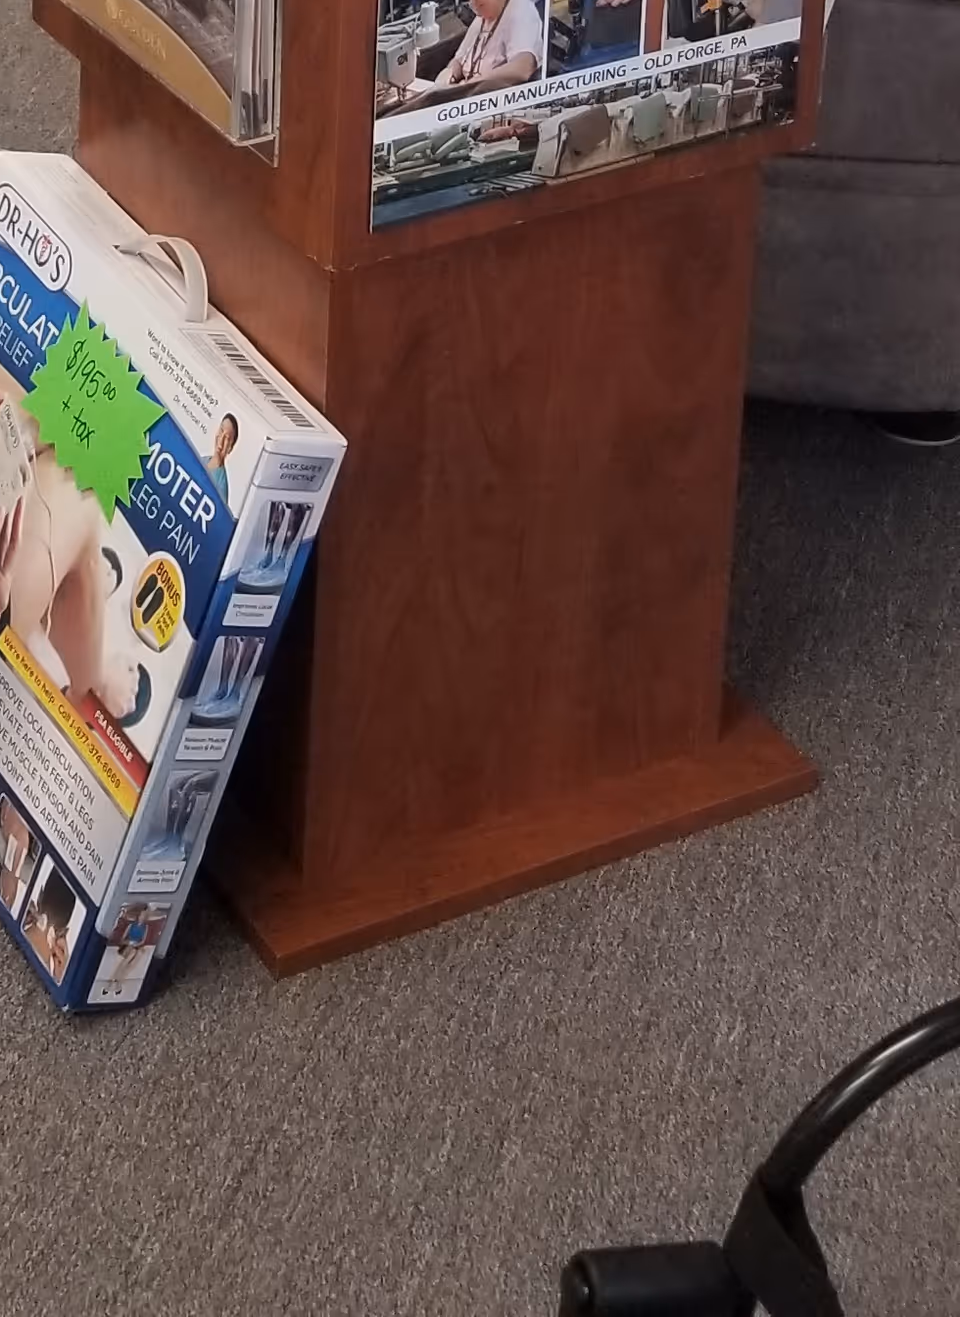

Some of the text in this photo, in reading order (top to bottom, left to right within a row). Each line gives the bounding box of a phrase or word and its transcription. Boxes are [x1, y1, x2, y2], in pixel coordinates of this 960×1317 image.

[437, 35, 747, 121] GOLDEN MANUFACTURING OLD FORGE, PA
[61, 395, 96, 450] + tax
[128, 472, 161, 519] LEG
[159, 510, 200, 565] PAIN
[144, 433, 217, 535] MOTER
[156, 560, 182, 609] BONUS
[19, 655, 34, 677] here
[34, 674, 41, 687] to
[57, 703, 71, 722] Call
[21, 732, 50, 772] ACHING
[49, 766, 69, 795] FEET
[74, 799, 94, 831] LEGS
[22, 706, 46, 744] LOCAL
[47, 738, 95, 805] CIRCULATION
[94, 710, 133, 762] FSA ELIGIBLE
[1, 755, 24, 786] JOINT
[23, 784, 40, 809] AND
[39, 806, 78, 860] ARTHRITIS
[76, 855, 96, 886] PAIN
[7, 736, 38, 780] MUSCLE
[37, 774, 69, 822] TENSION
[67, 819, 85, 844] AND
[84, 840, 104, 870] PAIN
